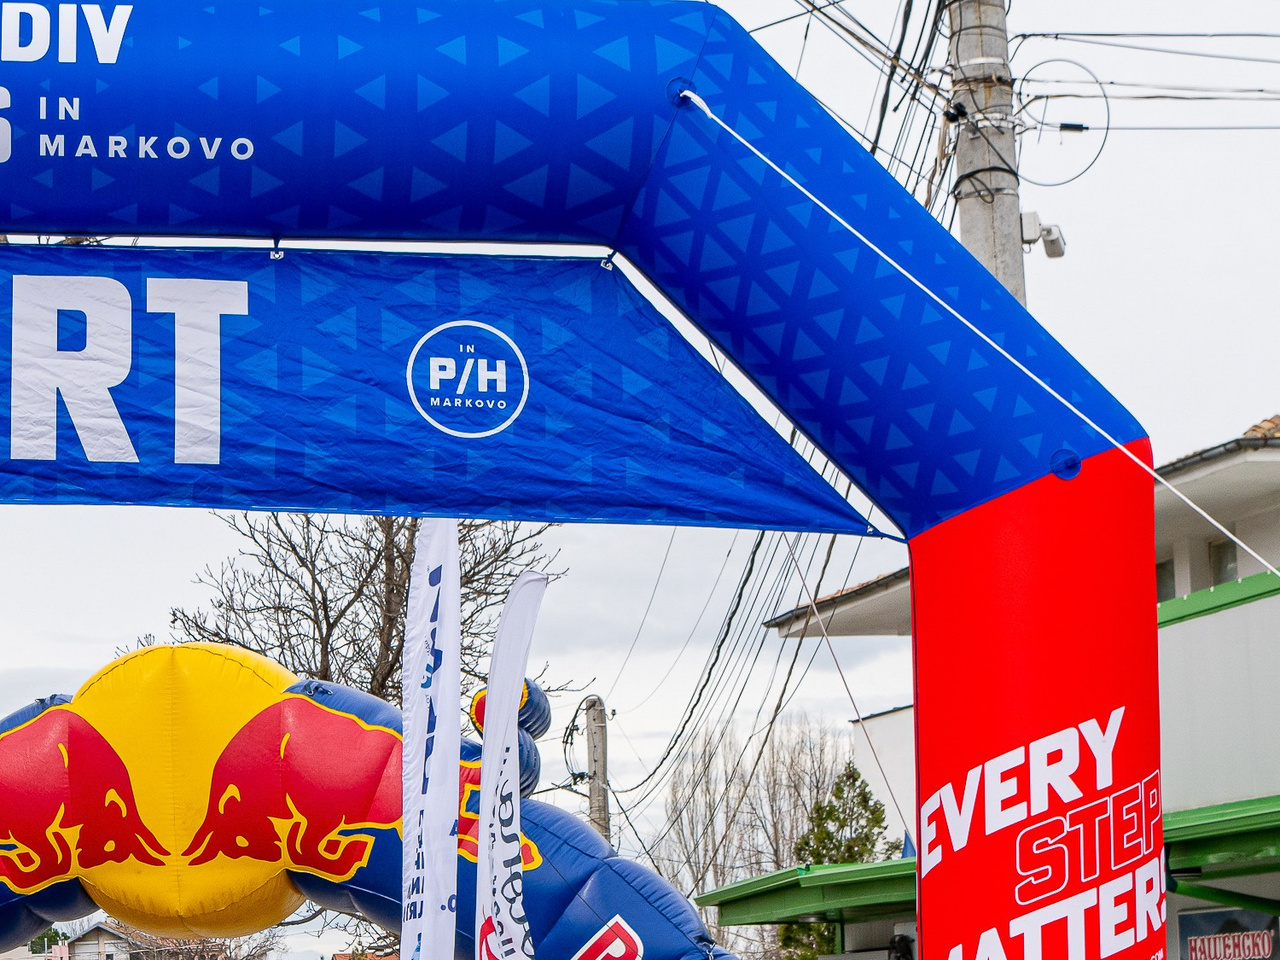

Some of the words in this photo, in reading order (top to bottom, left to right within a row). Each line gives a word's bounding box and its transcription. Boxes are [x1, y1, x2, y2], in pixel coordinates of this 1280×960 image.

[39, 97, 80, 120] IN
[39, 134, 255, 160] MARKOVO
[459, 344, 475, 353] IN
[429, 357, 507, 395] P/H
[430, 397, 507, 410] MARKOVO
[921, 706, 1125, 879] EVERY
[1015, 770, 1160, 906] STEP
